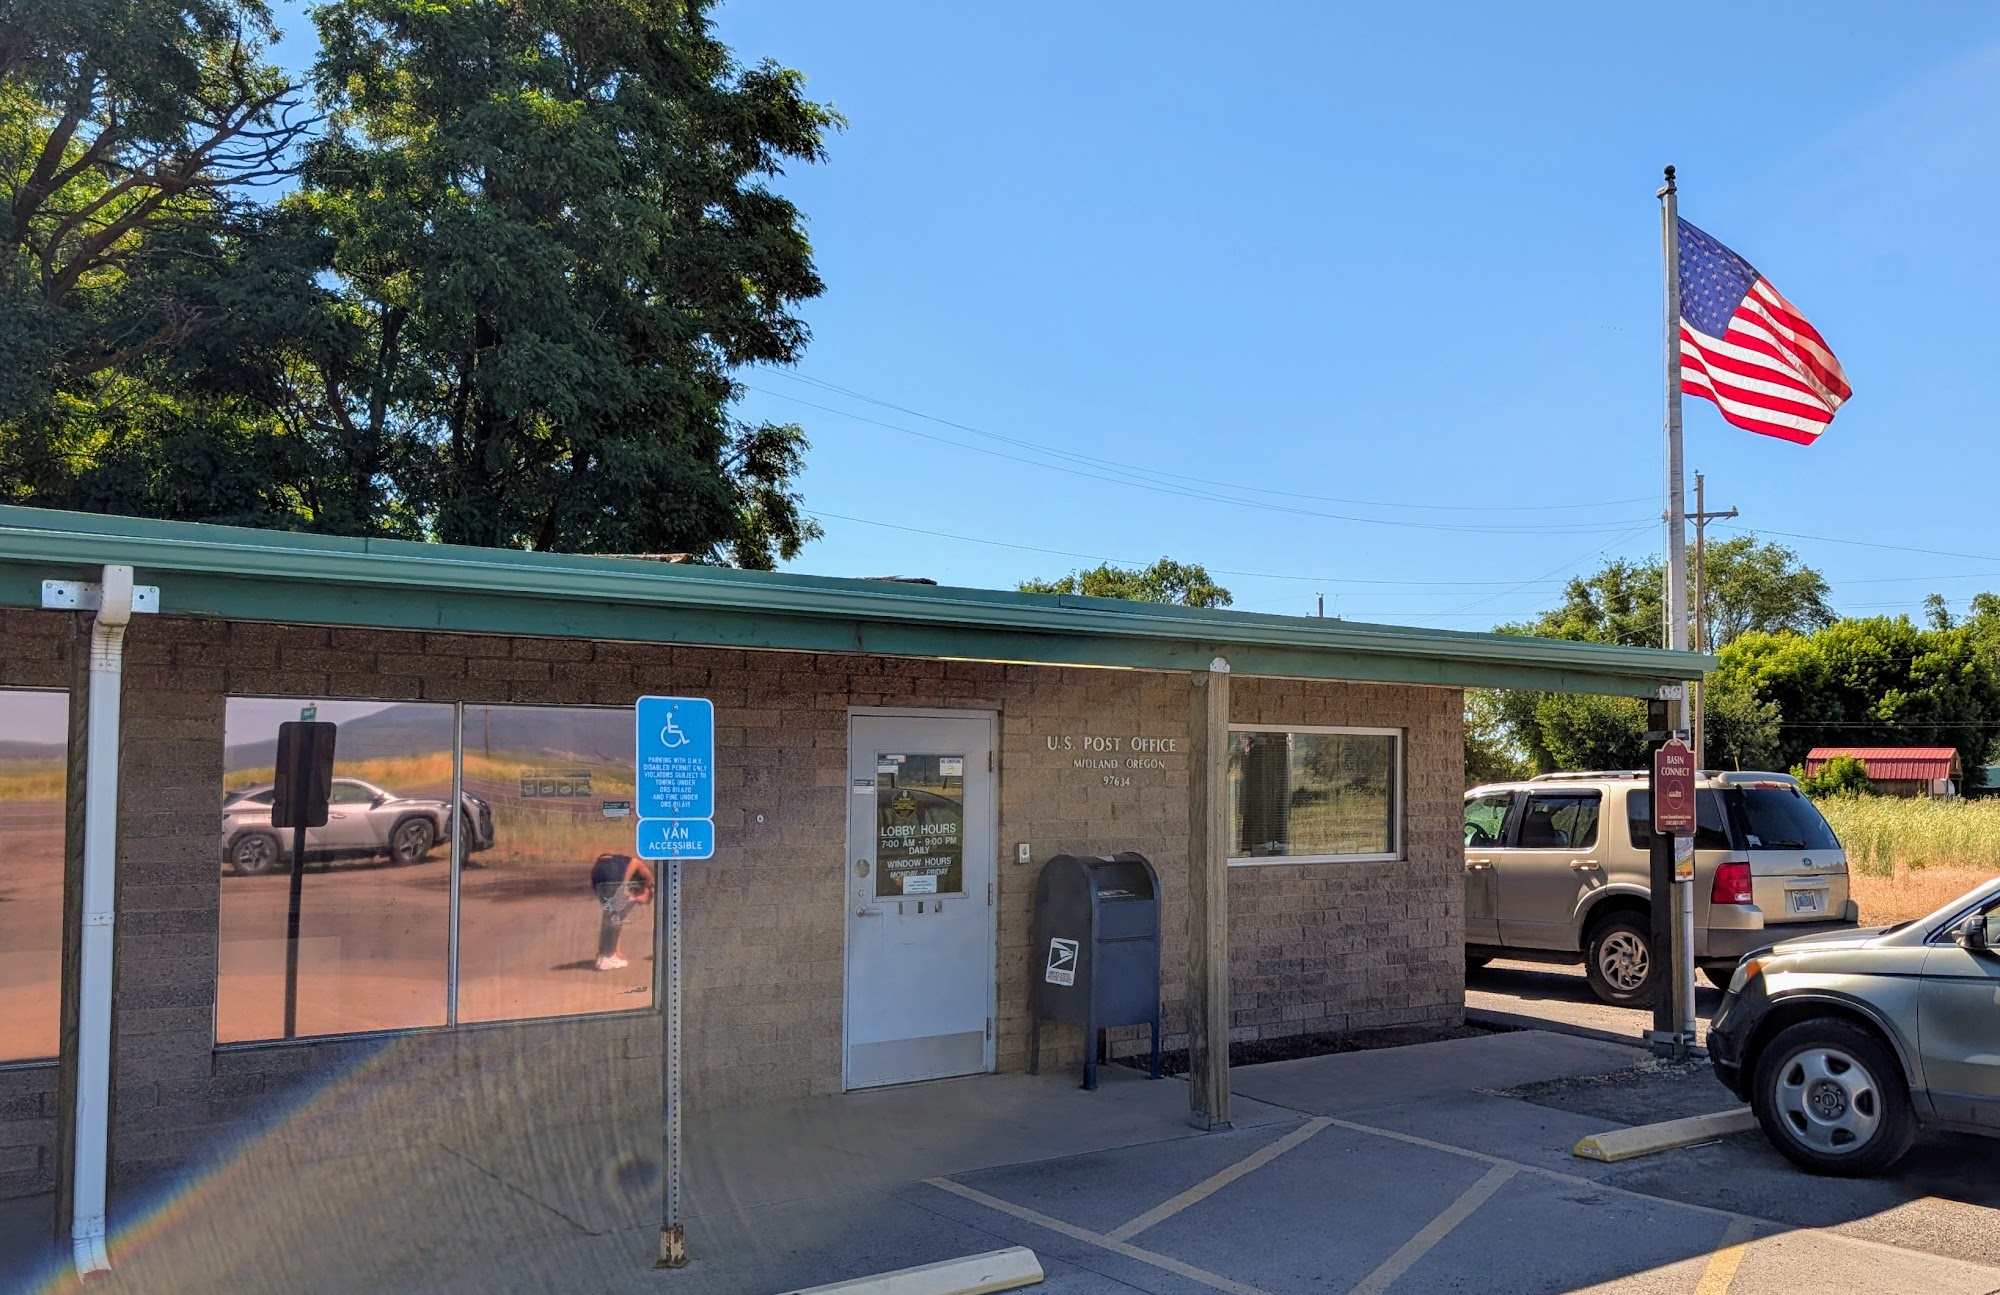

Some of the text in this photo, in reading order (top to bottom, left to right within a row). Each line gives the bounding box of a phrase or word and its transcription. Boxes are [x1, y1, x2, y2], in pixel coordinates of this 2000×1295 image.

[1084, 736, 1121, 751] POST
[1131, 737, 1176, 752] OFFICE
[1073, 758, 1165, 769] MIDLAND OREGON
[1666, 755, 1684, 765] BASIN
[674, 771, 699, 779] SUBJECT
[1661, 766, 1690, 777] CONNECT
[1103, 776, 1130, 787] 97634
[652, 793, 699, 801] AND FINE UNDER
[662, 827, 689, 840] VAN
[881, 823, 957, 837] LOBBY HOURS
[648, 841, 703, 850] ACCESSIBLE
[881, 840, 899, 848] 7:00
[902, 838, 915, 847] AM
[924, 837, 942, 846] 9:00
[945, 836, 957, 845] PM
[908, 846, 930, 855] DAILY
[887, 857, 952, 869] WINDOW HOURS
[890, 870, 918, 879] MONDAY
[926, 868, 949, 876] FRIDAY
